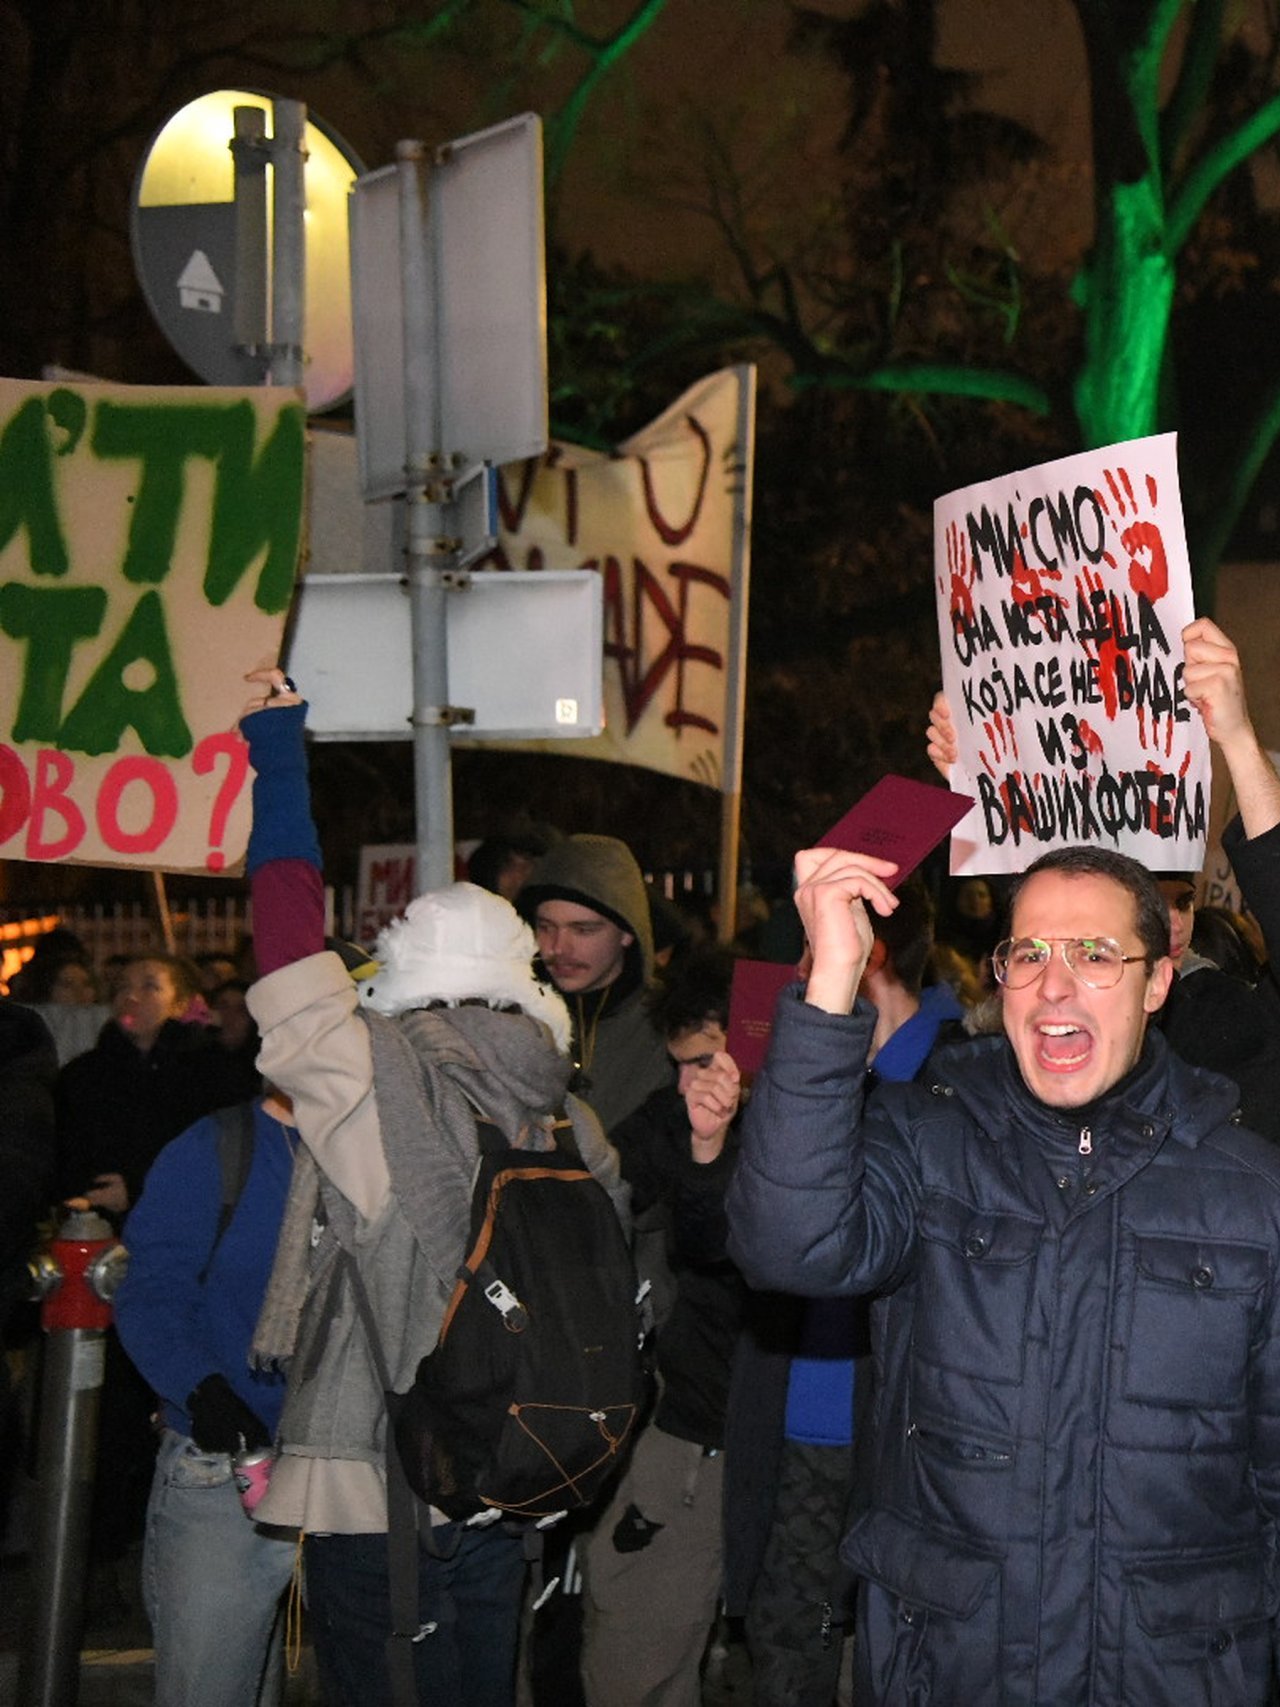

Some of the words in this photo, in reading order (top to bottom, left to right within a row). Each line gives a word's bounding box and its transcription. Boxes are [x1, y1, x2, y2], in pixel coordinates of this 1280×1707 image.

[966, 502, 1028, 582] МИ
[1029, 485, 1105, 571] СМО
[1001, 595, 1076, 648] ИСТА
[1075, 588, 1172, 660] ДЕЦА
[962, 657, 1035, 725] КОЈА
[1034, 656, 1067, 708] СЕ
[1070, 657, 1104, 705] НЕ
[1115, 654, 1191, 722] ВИДЕ
[1035, 712, 1088, 770] ИЗ
[977, 770, 1101, 847] ВАШИХ
[1097, 759, 1207, 847] ФОТЕЛА
